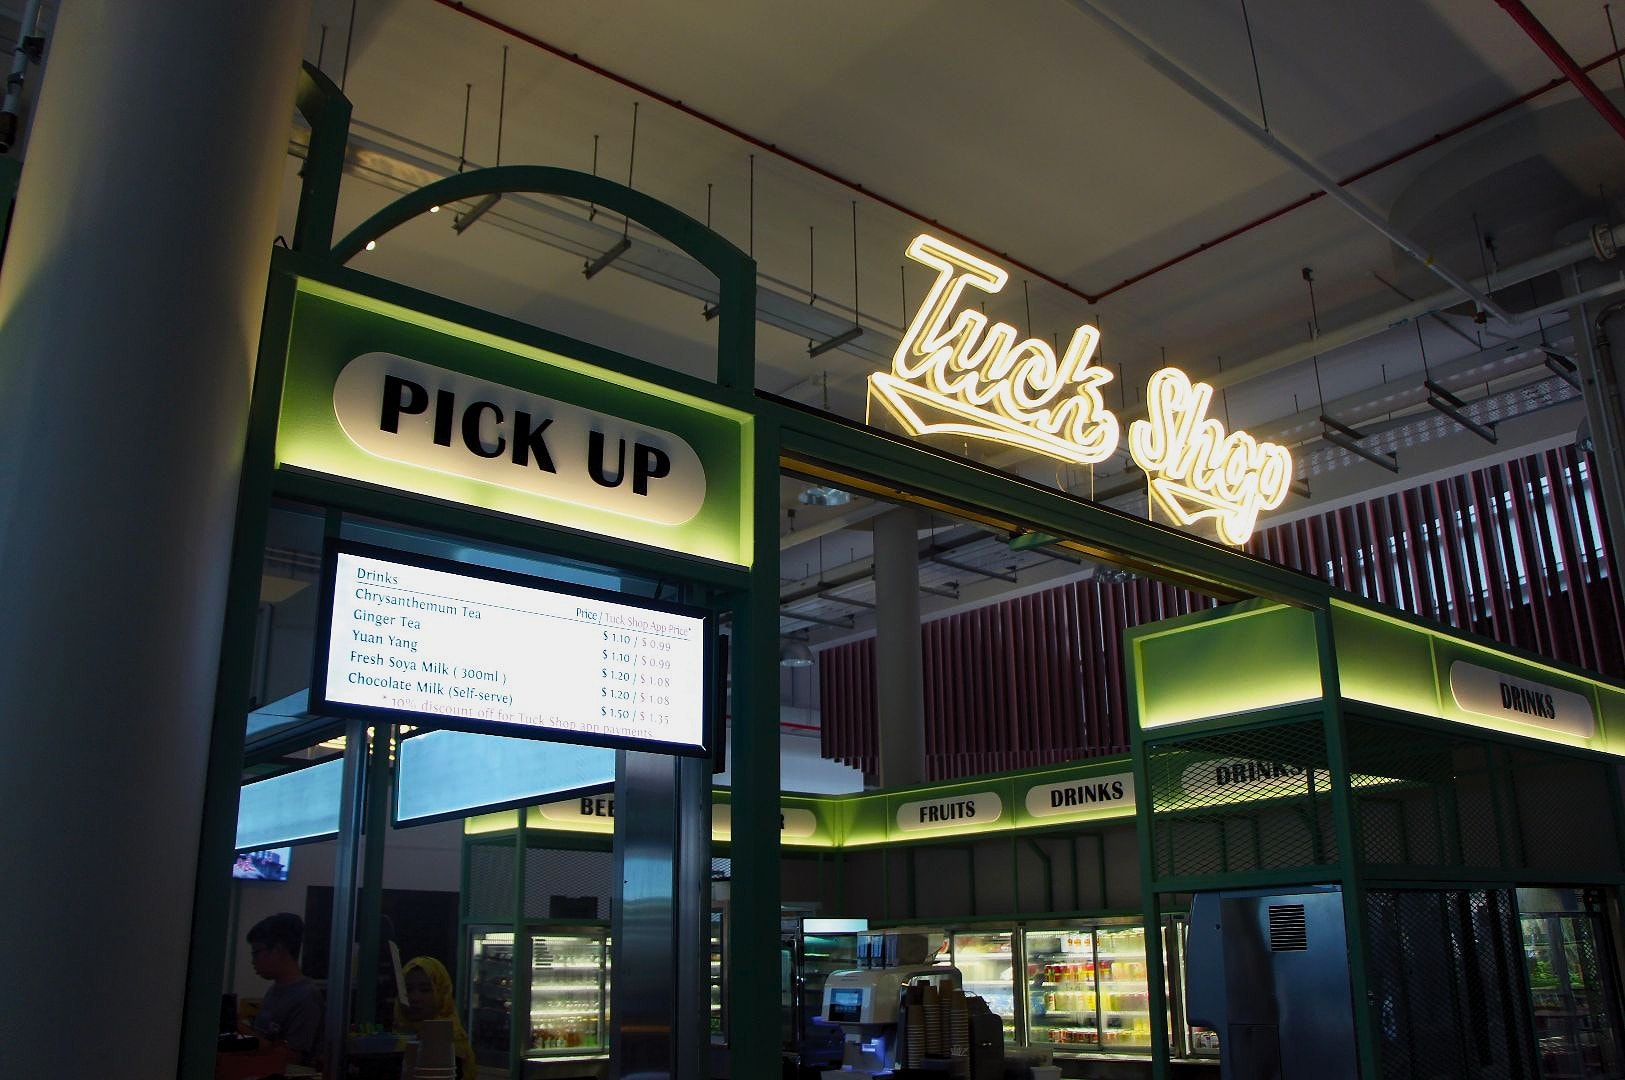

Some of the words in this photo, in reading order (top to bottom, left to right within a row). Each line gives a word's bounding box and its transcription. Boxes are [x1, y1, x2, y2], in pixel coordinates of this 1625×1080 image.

[888, 234, 1118, 455] Tuck
[1128, 367, 1292, 545] Shop
[380, 375, 557, 475] PICK
[587, 430, 670, 496] UP
[356, 567, 398, 584] Drinks
[355, 587, 457, 616] Chrysanthemum
[462, 606, 481, 620] Tea
[353, 608, 396, 627] Ginger
[400, 615, 421, 631] Tea
[576, 607, 598, 621] Price
[605, 612, 625, 625] Tuck
[627, 615, 648, 630] Shop
[650, 621, 666, 633] App
[352, 629, 383, 645] Yuan
[388, 634, 418, 653] Yang
[350, 651, 384, 666] Fresh
[388, 656, 417, 672] Soya
[422, 660, 449, 676] Milk
[348, 671, 412, 691] Chocolate
[416, 681, 444, 696] Milk
[449, 685, 513, 707] (Self-serve)
[1500, 682, 1555, 719] DRINKS
[421, 699, 473, 716] discount
[477, 707, 494, 719] off
[498, 708, 514, 722] for
[518, 712, 544, 726] Tuck
[549, 715, 576, 730] Shop
[1051, 781, 1124, 808] DRINKS
[919, 800, 976, 823] FRUITS
